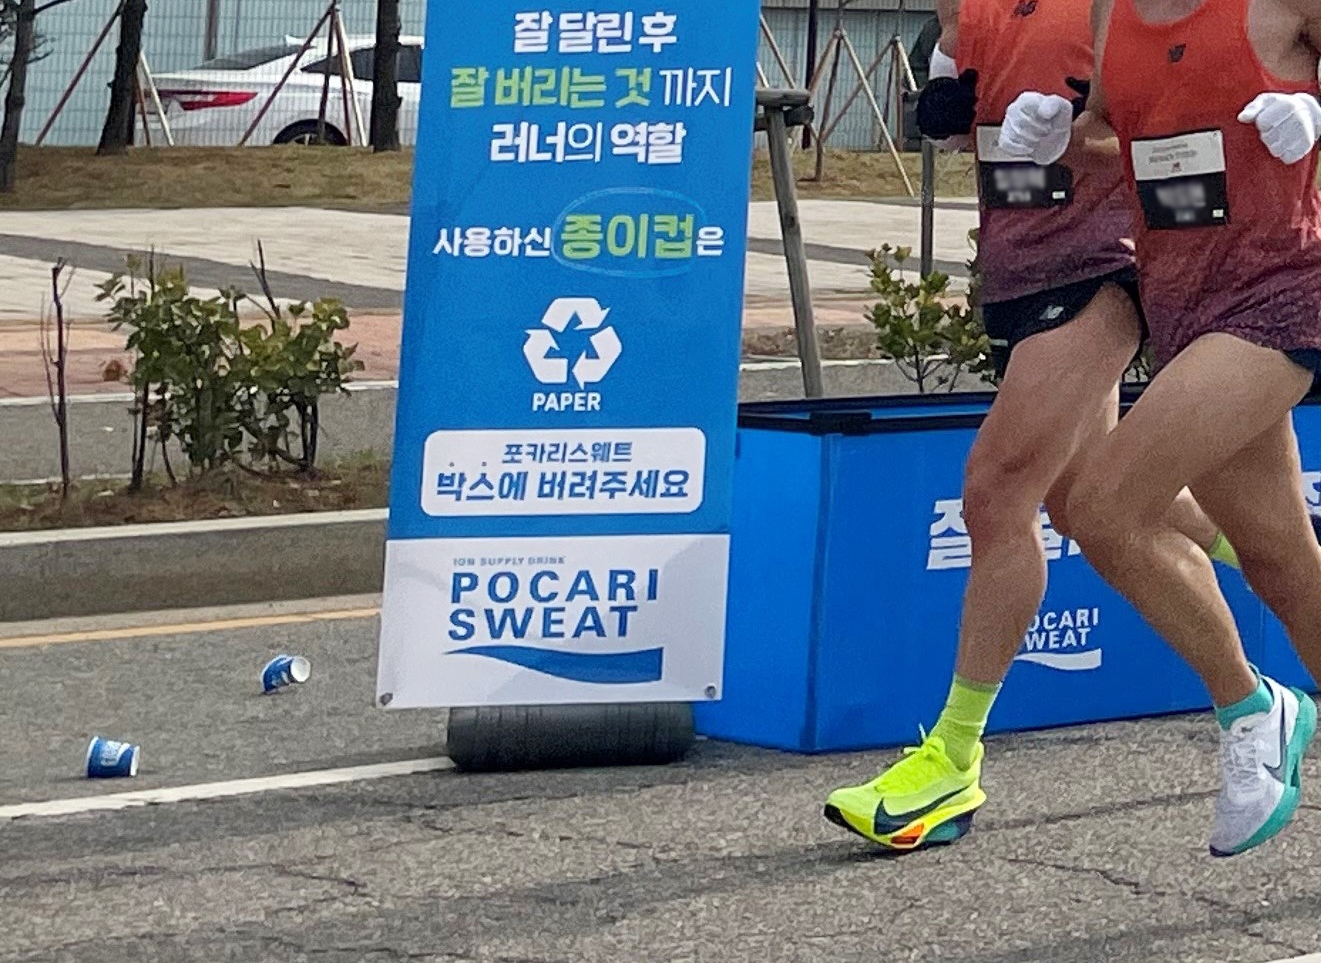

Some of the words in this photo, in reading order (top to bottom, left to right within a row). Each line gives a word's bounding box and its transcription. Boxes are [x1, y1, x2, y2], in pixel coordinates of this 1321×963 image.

[513, 10, 554, 54] 잘
[558, 10, 634, 54] 달린
[638, 11, 678, 54] 후
[450, 65, 490, 109] 잘
[494, 65, 607, 109] 버리는
[614, 66, 653, 109] 것
[658, 66, 733, 108] 까지
[490, 121, 603, 163] 러너의
[610, 121, 687, 164] 역할
[433, 226, 552, 258] 사용하신
[560, 213, 725, 260] 종이컵은
[532, 392, 601, 412] PAPER
[501, 441, 633, 464] 포카리스웨트
[436, 470, 529, 501] 박스에
[537, 469, 690, 500] 버려주세요
[480, 556, 524, 566] SUPPLY
[527, 555, 566, 565] DRINK
[451, 568, 659, 604] POCARI
[448, 605, 639, 641] SWEAT
[1024, 627, 1092, 651] WEAT
